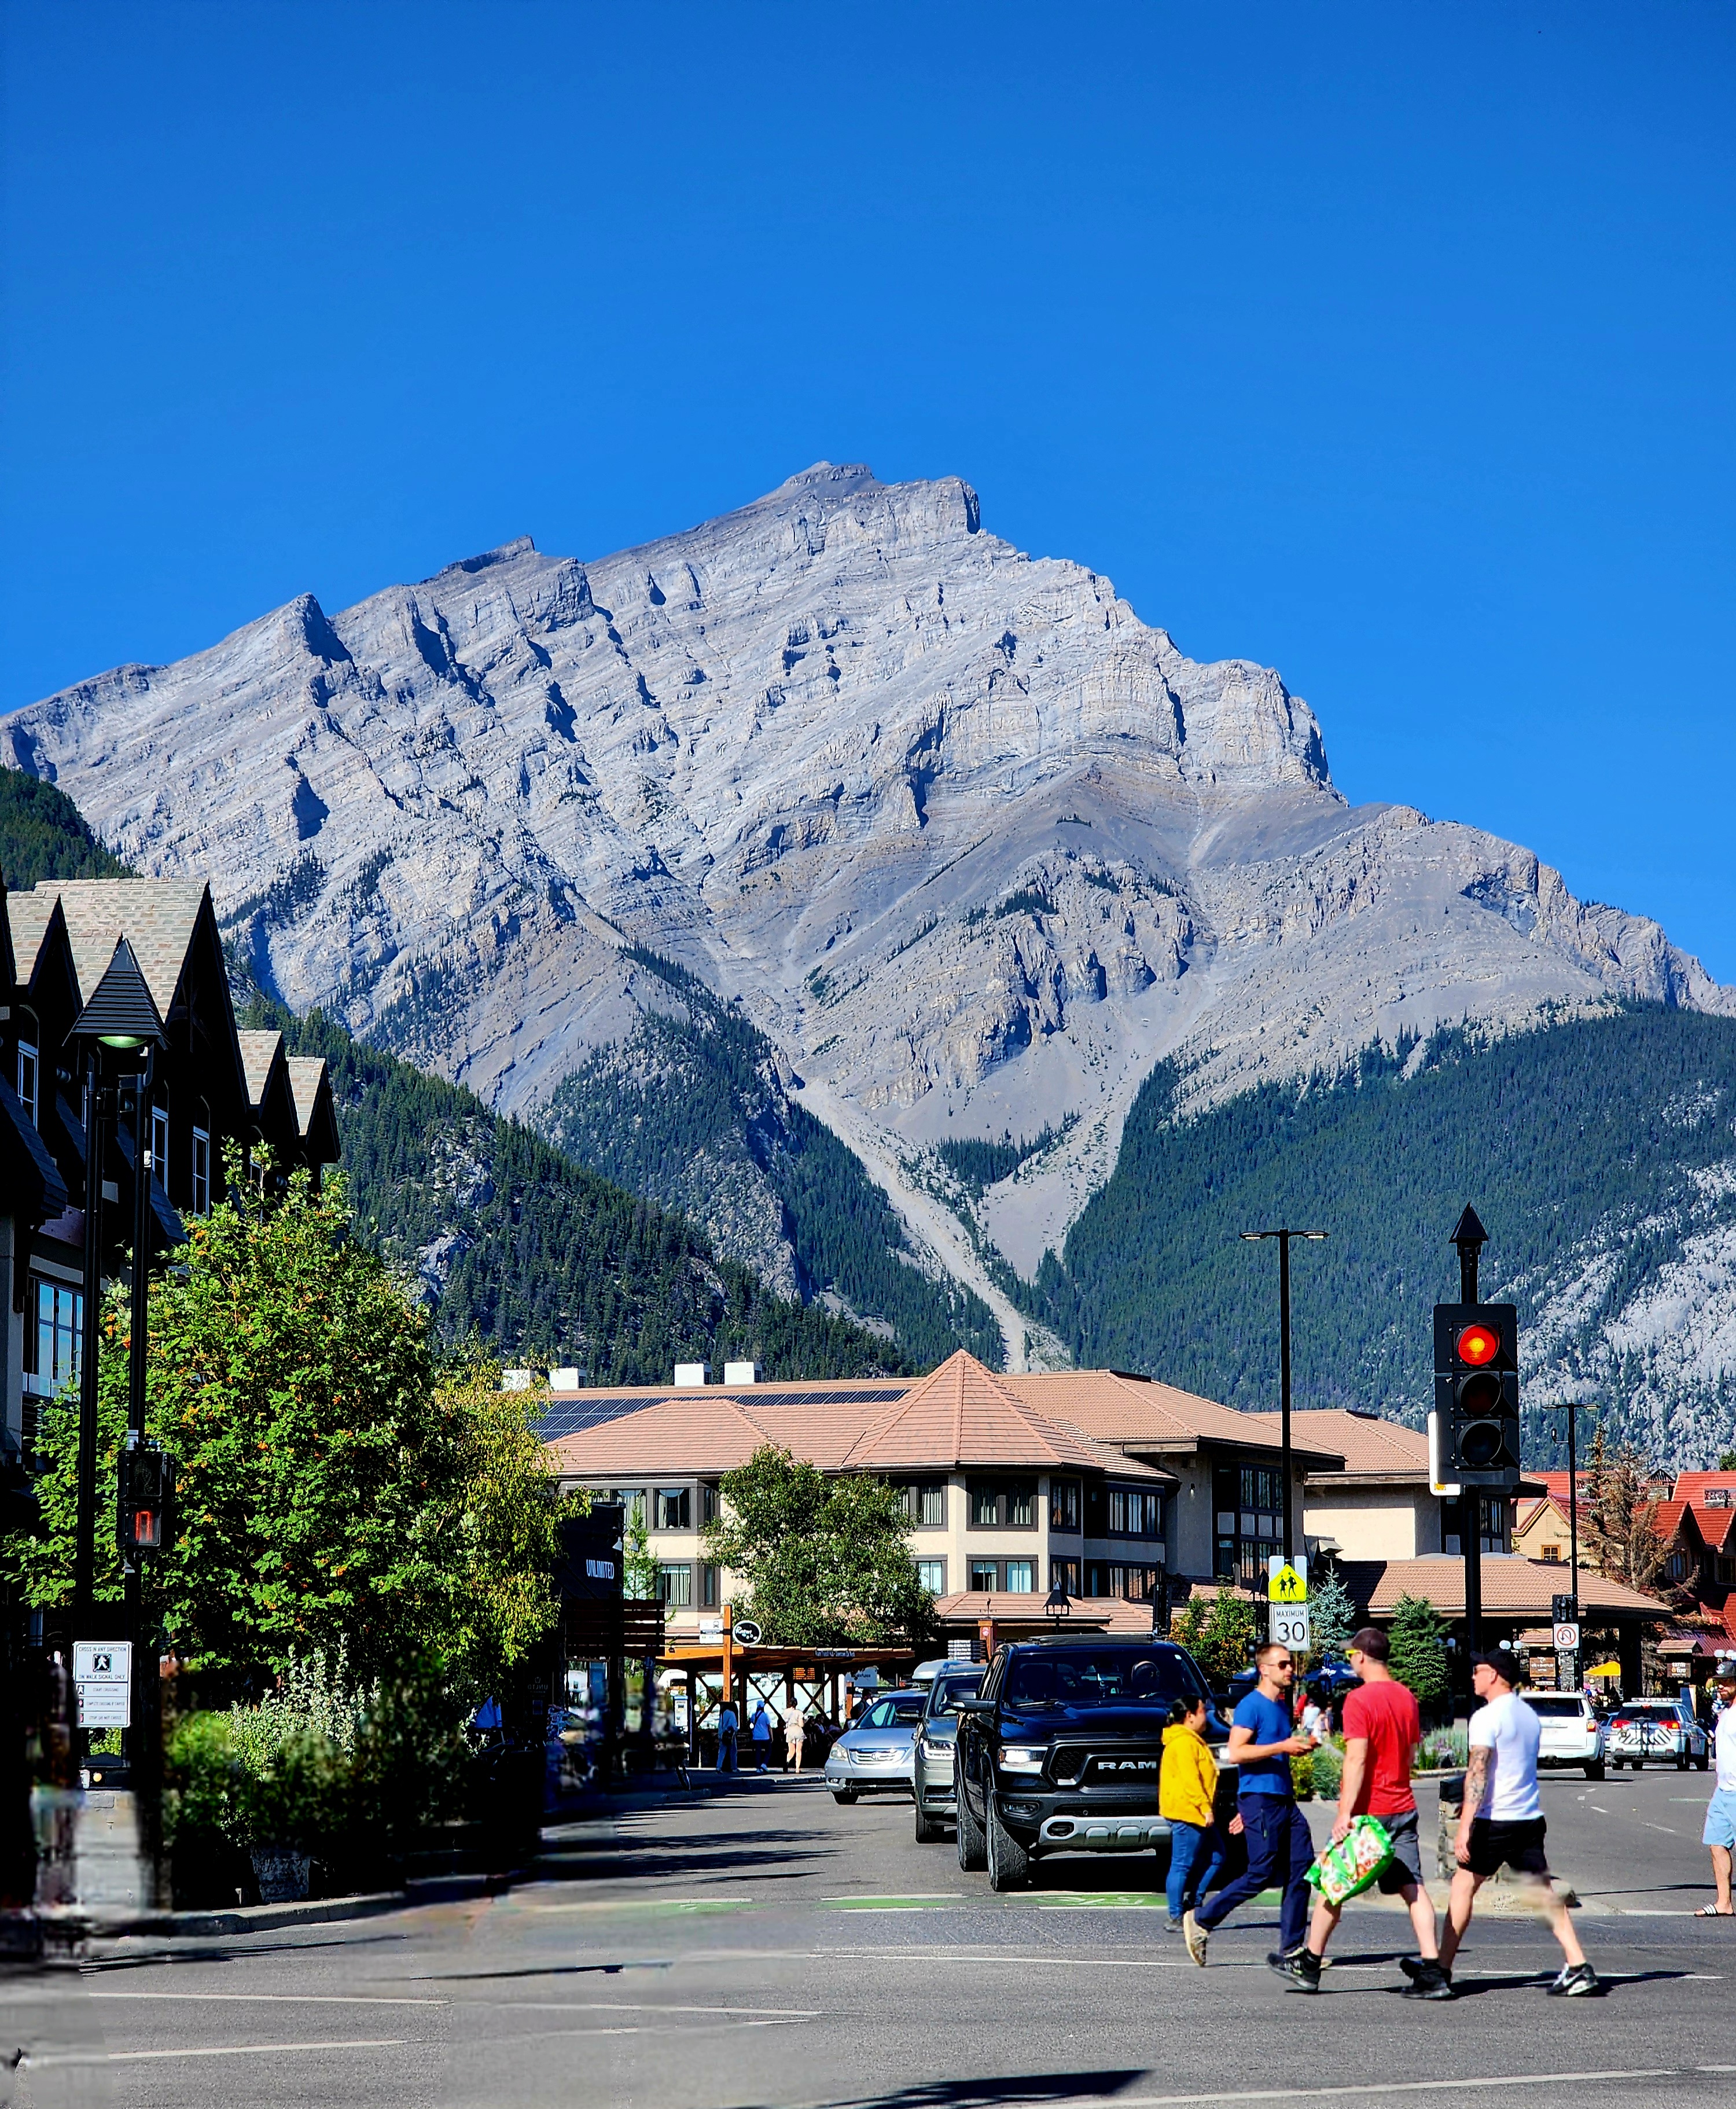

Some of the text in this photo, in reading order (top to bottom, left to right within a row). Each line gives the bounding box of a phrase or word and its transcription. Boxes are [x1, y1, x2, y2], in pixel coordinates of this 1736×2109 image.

[586, 1559, 614, 1579] UNLIMITED
[1278, 1622, 1305, 1642] 30
[1098, 1761, 1156, 1769] RAM
